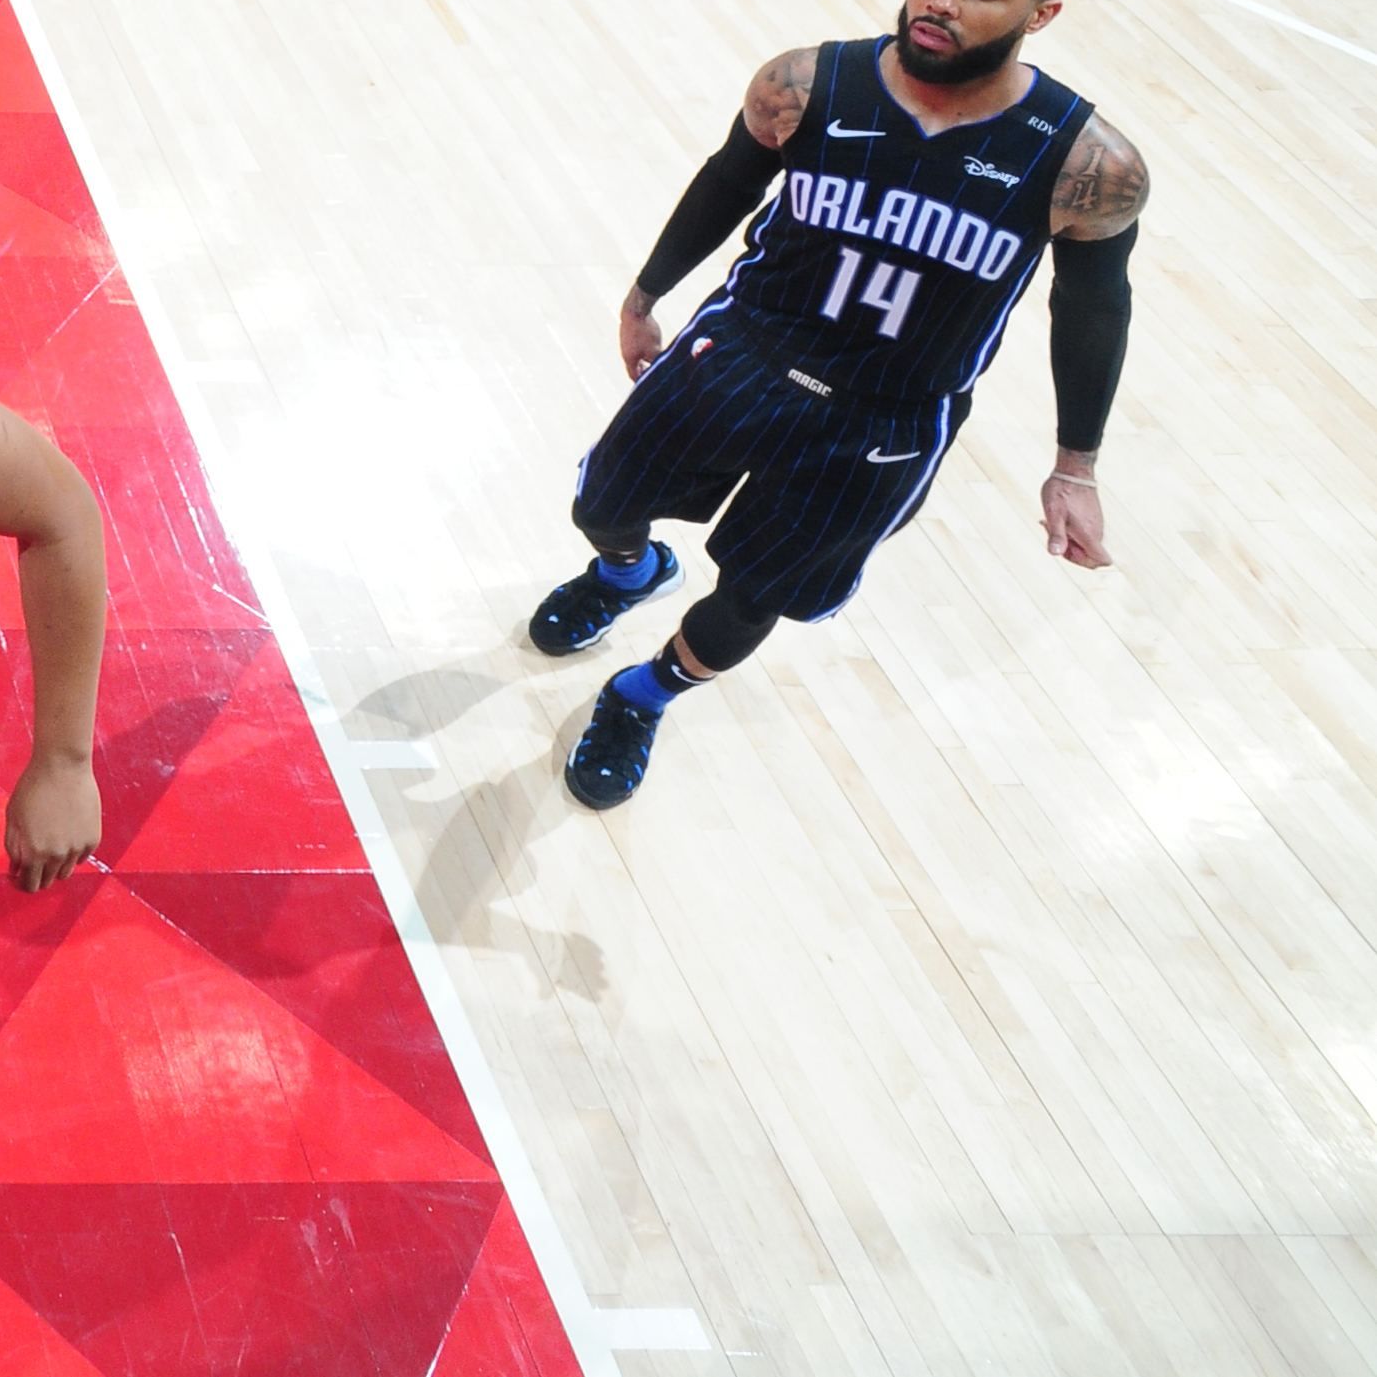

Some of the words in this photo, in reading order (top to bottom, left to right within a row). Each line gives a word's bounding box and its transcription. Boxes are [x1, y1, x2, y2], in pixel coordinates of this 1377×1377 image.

[1027, 115, 1058, 136] RDV
[963, 155, 1021, 189] Disney
[789, 171, 1023, 283] ORLANDO
[820, 246, 925, 341] 14
[787, 368, 833, 397] MAGIC
